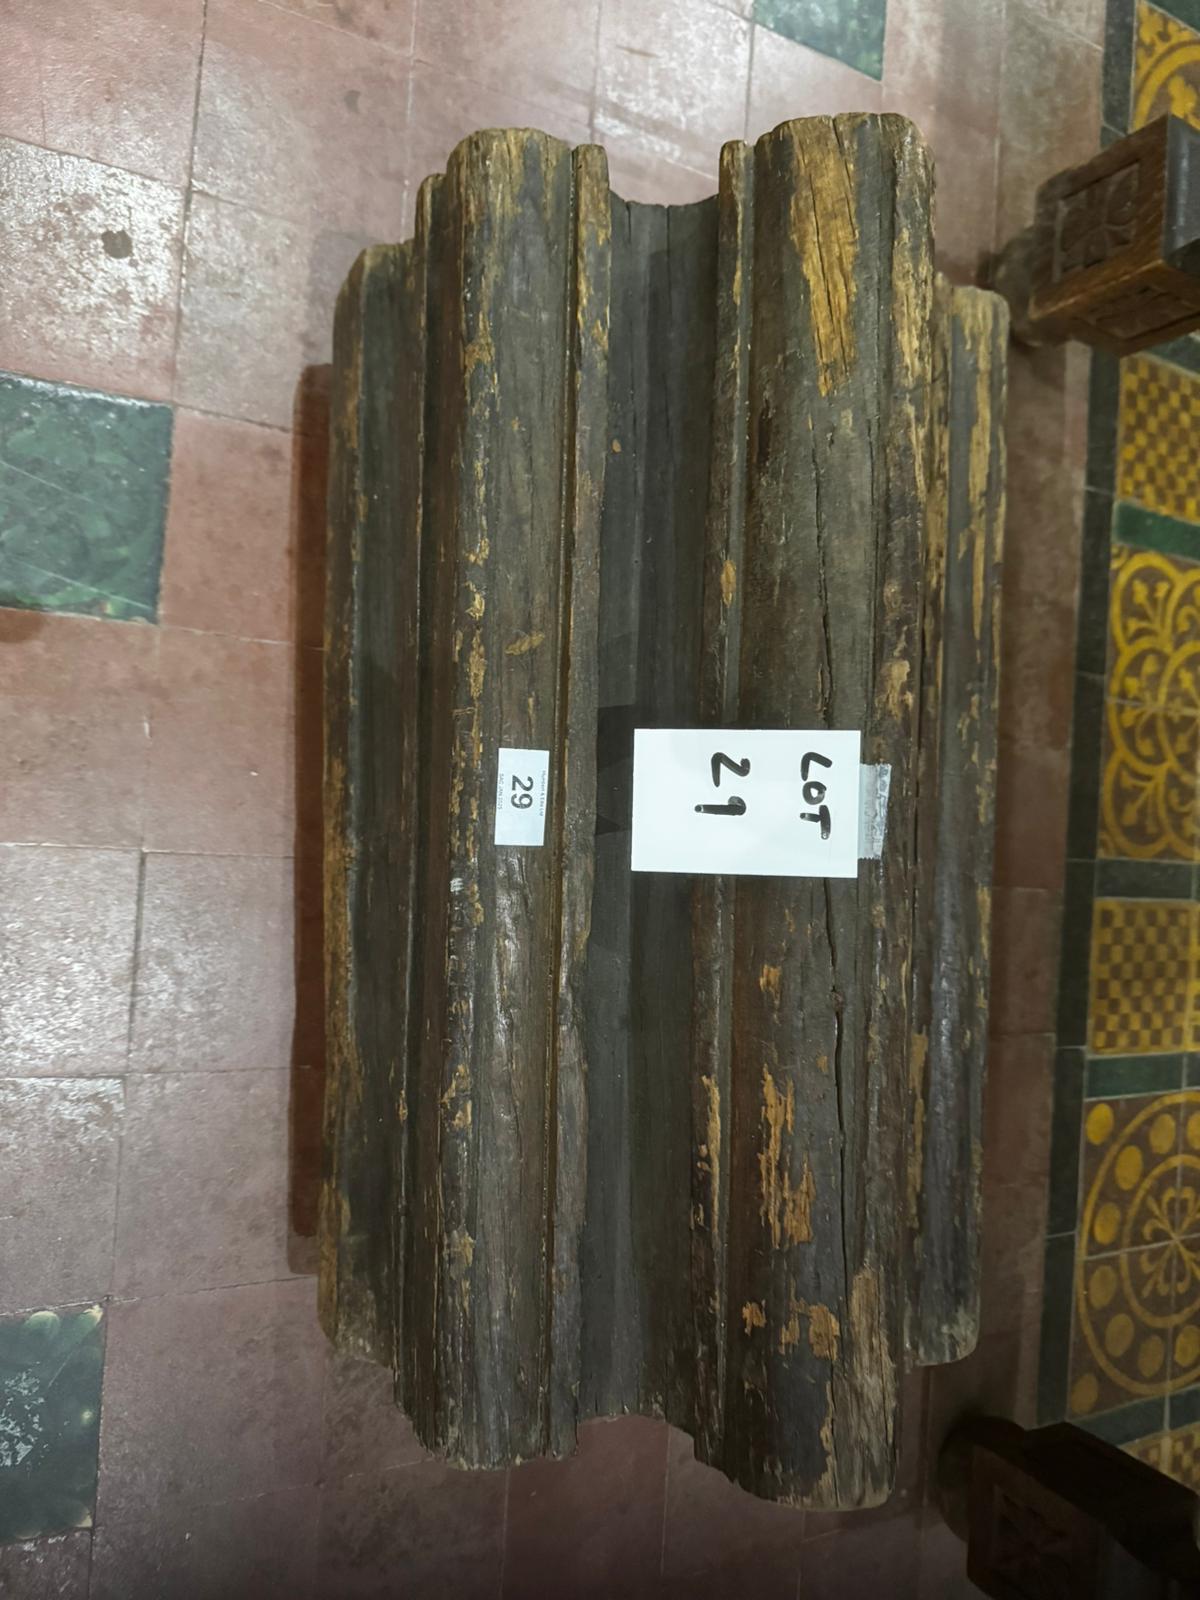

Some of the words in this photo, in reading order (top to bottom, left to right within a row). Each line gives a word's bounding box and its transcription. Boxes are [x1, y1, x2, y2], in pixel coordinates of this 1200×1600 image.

[510, 775, 534, 810] 29
[694, 752, 751, 817] 29
[800, 752, 833, 840] LOT
